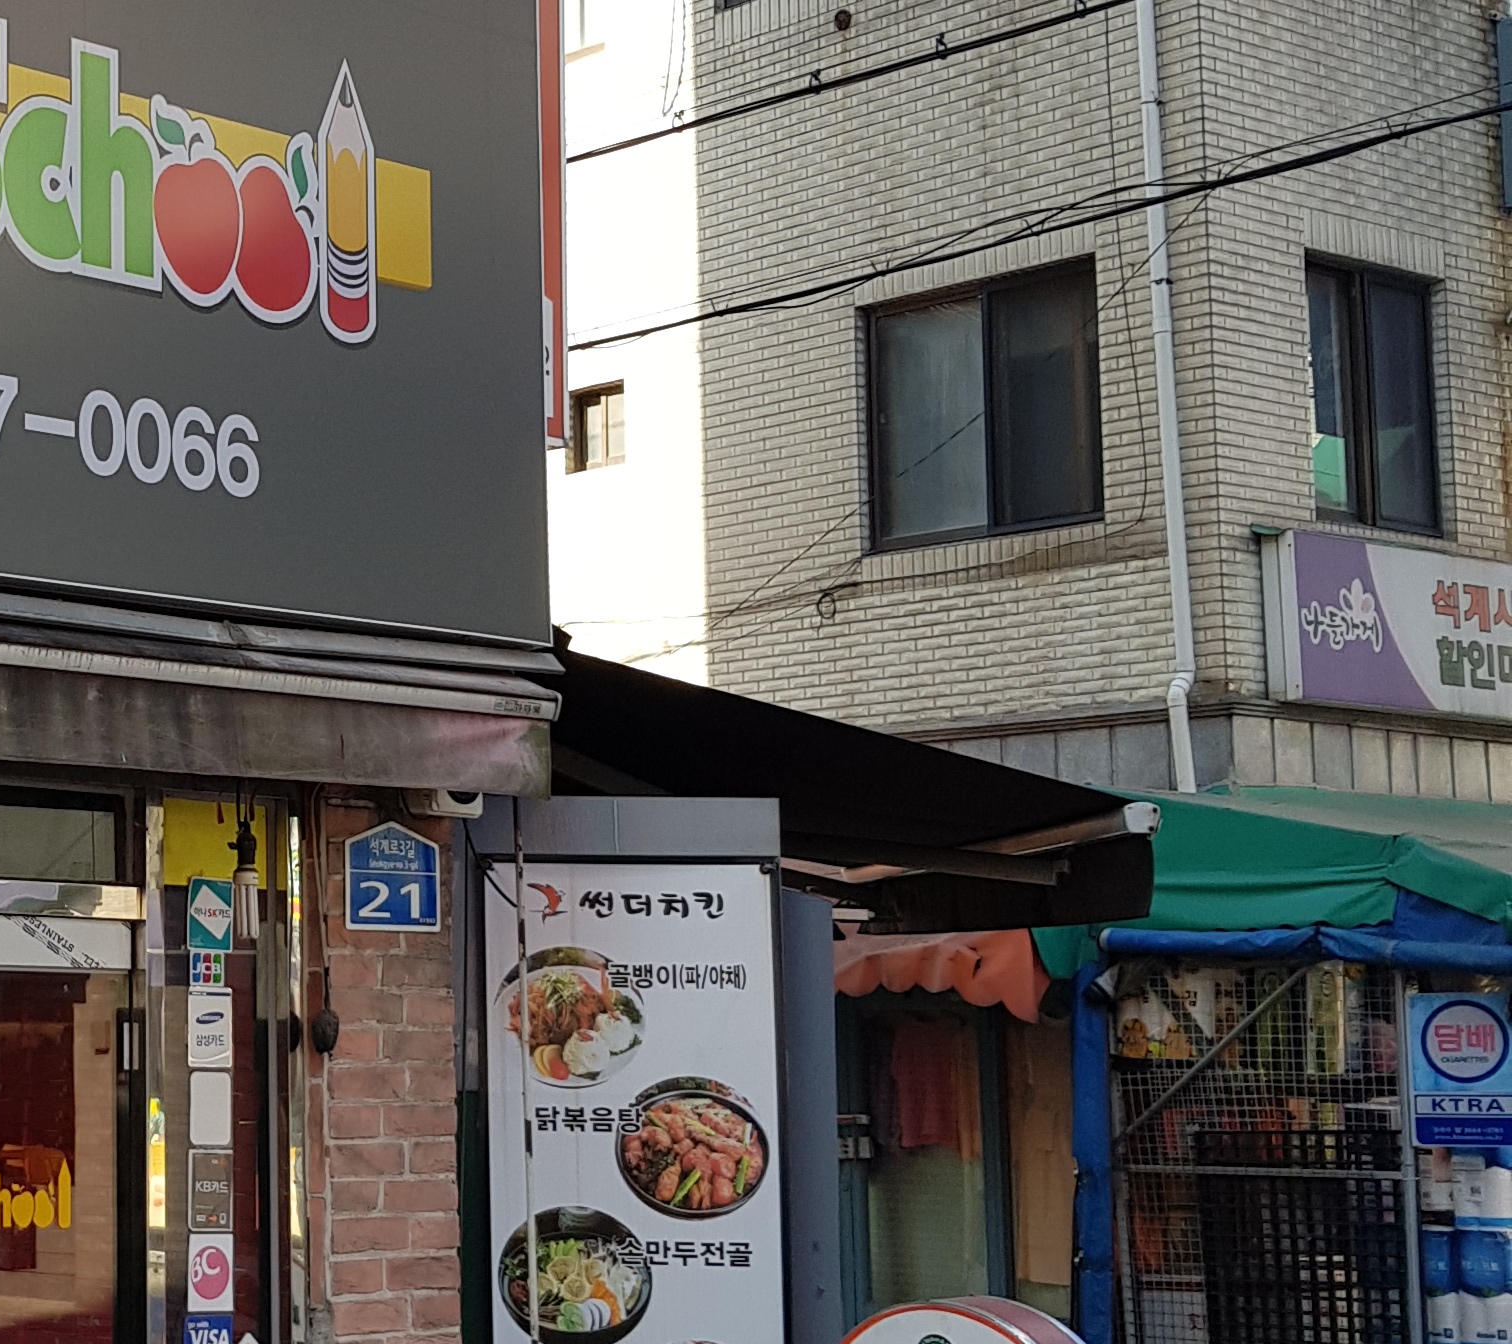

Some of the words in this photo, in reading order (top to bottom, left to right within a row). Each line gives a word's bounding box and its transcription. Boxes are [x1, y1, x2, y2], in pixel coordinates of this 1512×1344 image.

[369, 838, 415, 858] 석계로3길
[358, 880, 420, 919] 21
[579, 890, 726, 920] 썬더치킨
[608, 963, 747, 990] 골뱅이(파/야채)
[196, 1034, 226, 1047] 삼성카드
[1434, 1023, 1496, 1053] 담배
[534, 1105, 643, 1134] 닭볶음탕
[1431, 1097, 1506, 1113] KTRA
[195, 1180, 229, 1193] KB카드
[191, 1249, 221, 1283] BC
[617, 1237, 753, 1268] 손만두전골
